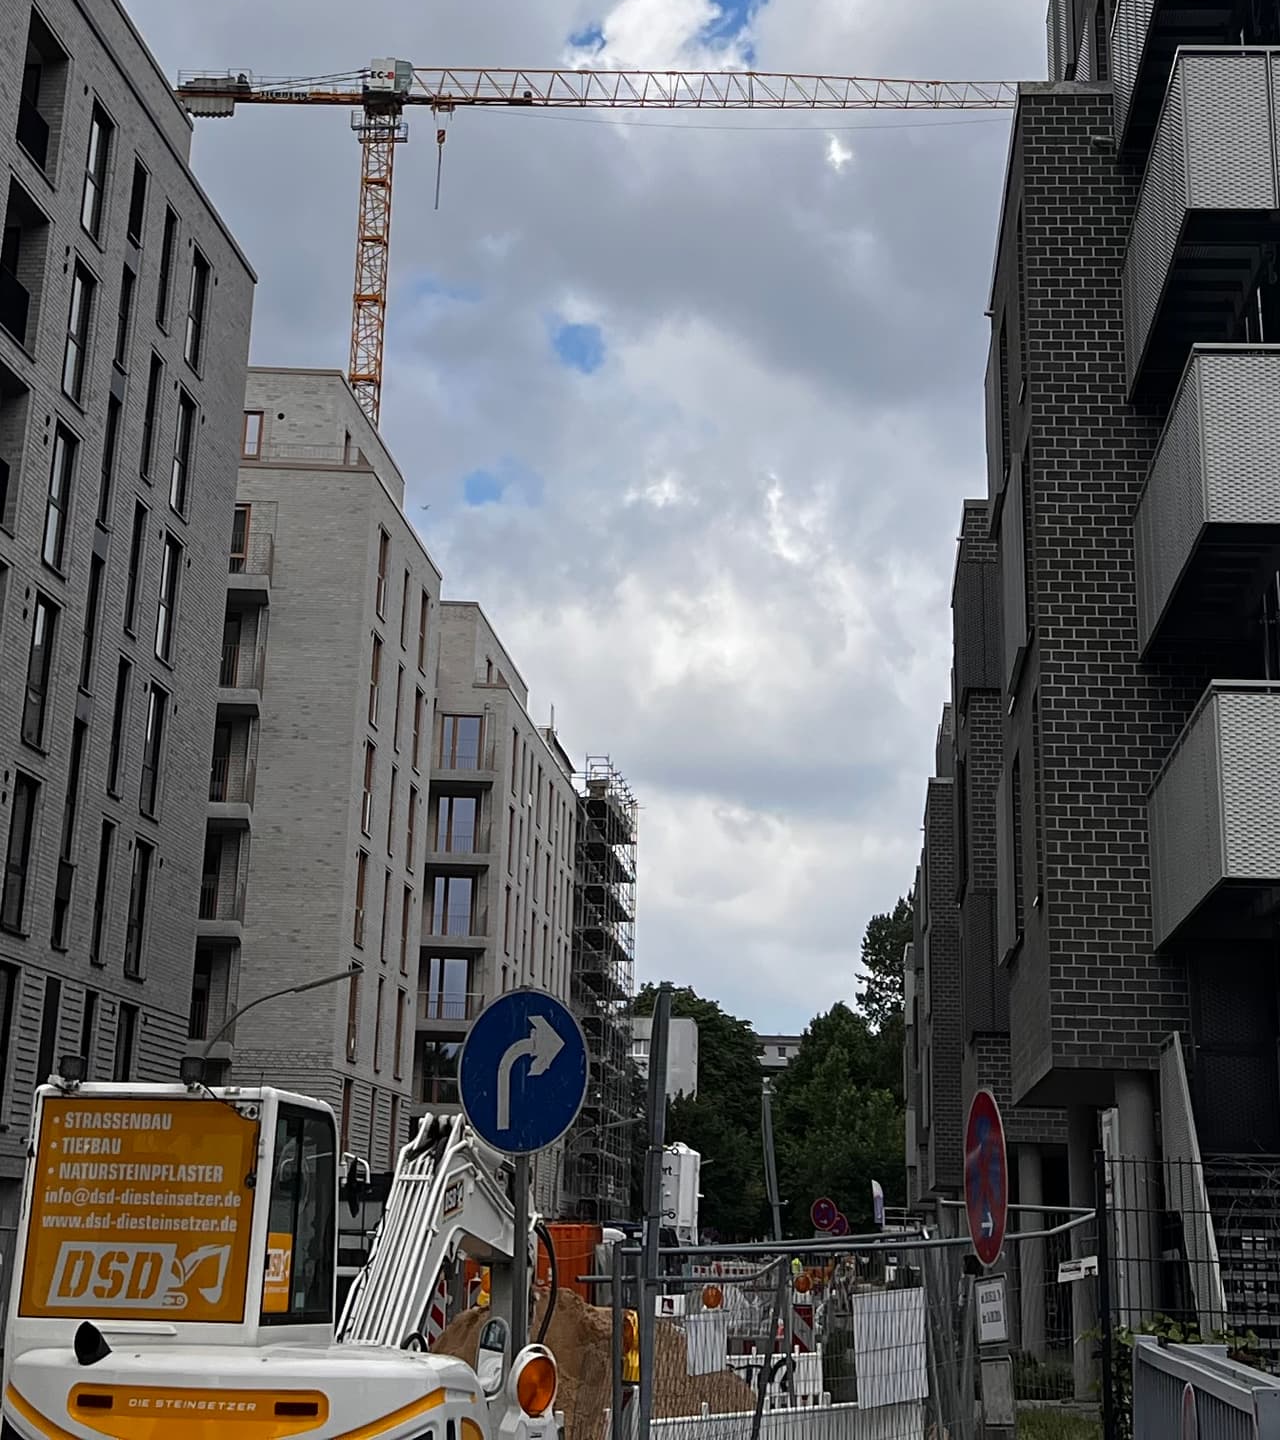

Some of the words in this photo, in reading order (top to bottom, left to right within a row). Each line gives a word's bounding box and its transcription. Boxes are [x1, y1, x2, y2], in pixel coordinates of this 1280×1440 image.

[370, 70, 394, 80] EC-B
[64, 1111, 173, 1130] STRASSENBAU
[62, 1136, 122, 1155] TIEFBAU
[59, 1162, 224, 1183] NATURSTEINPFLASTER
[44, 1186, 241, 1207] info@dsd-diesteinsetzer.de
[42, 1212, 238, 1232] www.dsd-diesteinsetzer.de
[56, 1249, 164, 1300] DSD
[128, 1398, 150, 1408] DIE
